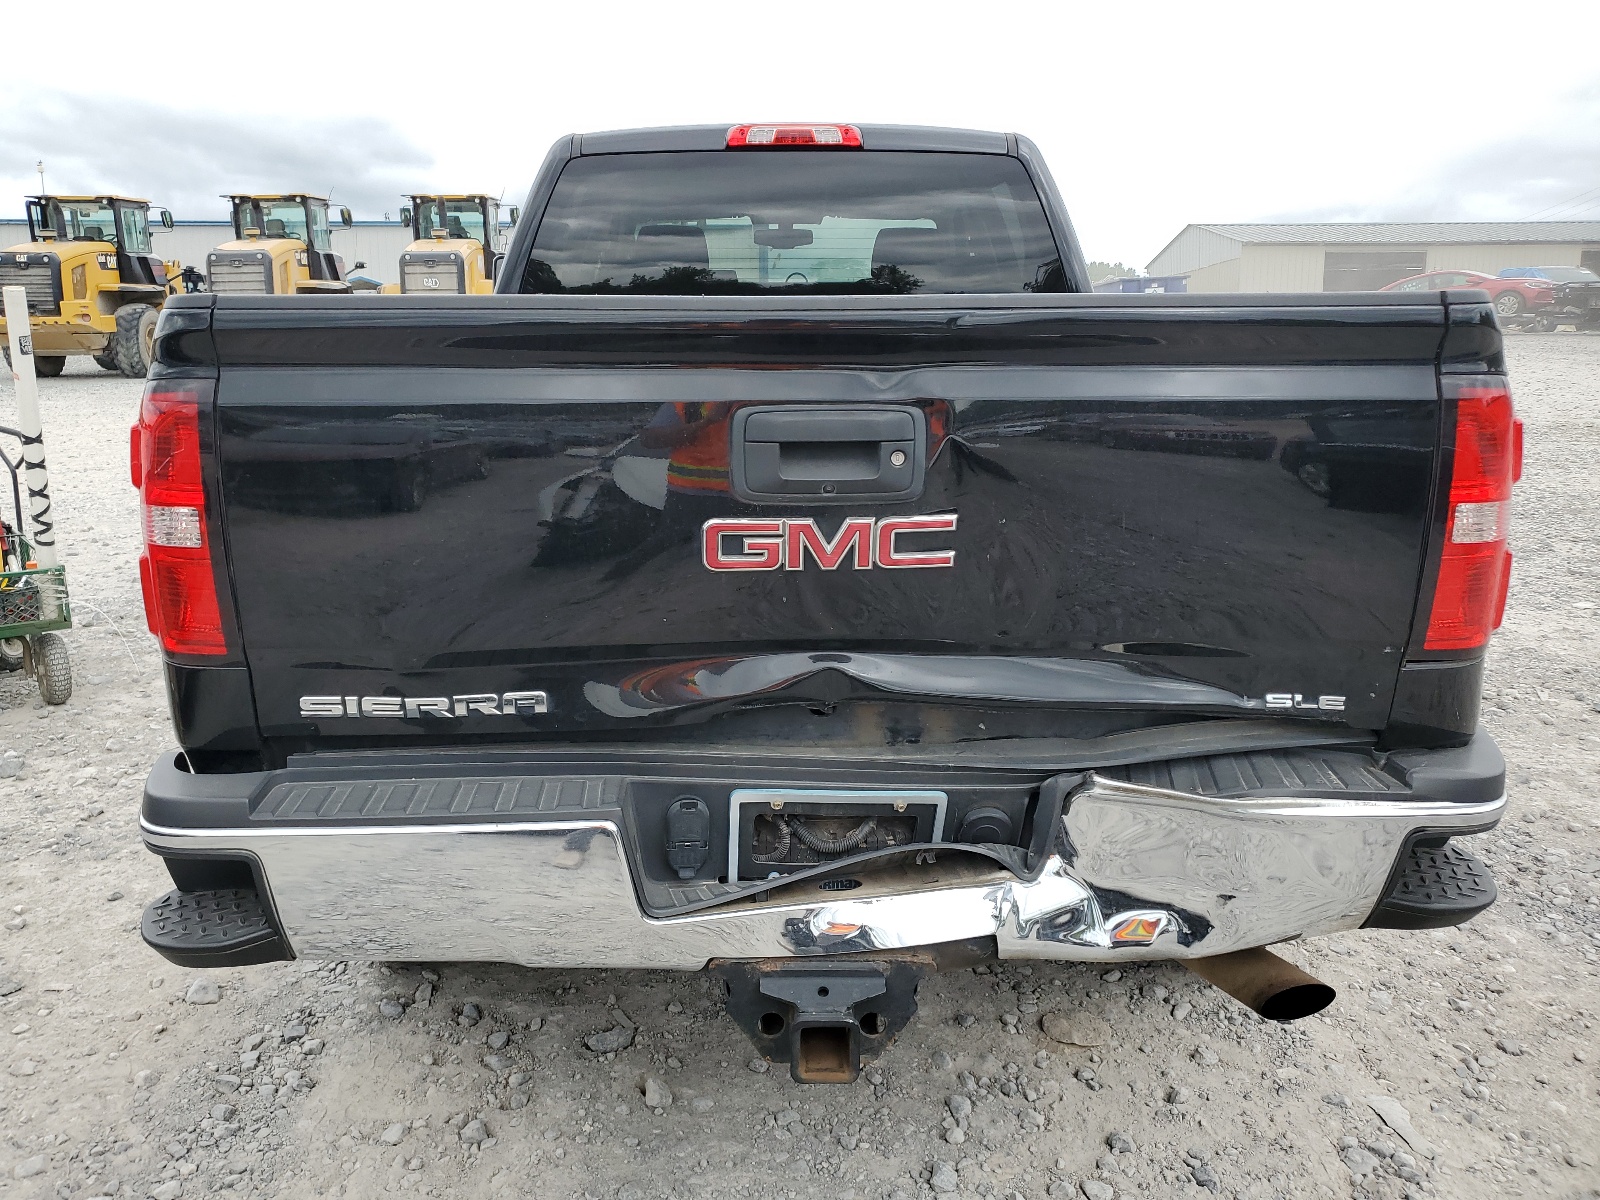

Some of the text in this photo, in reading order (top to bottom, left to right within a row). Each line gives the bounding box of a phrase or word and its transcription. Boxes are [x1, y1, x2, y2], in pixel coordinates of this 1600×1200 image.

[16, 254, 28, 262] CAT
[423, 278, 440, 288] CAT
[702, 514, 958, 572] GMC
[299, 691, 548, 718] SIERRA
[1265, 693, 1346, 711] SLE
